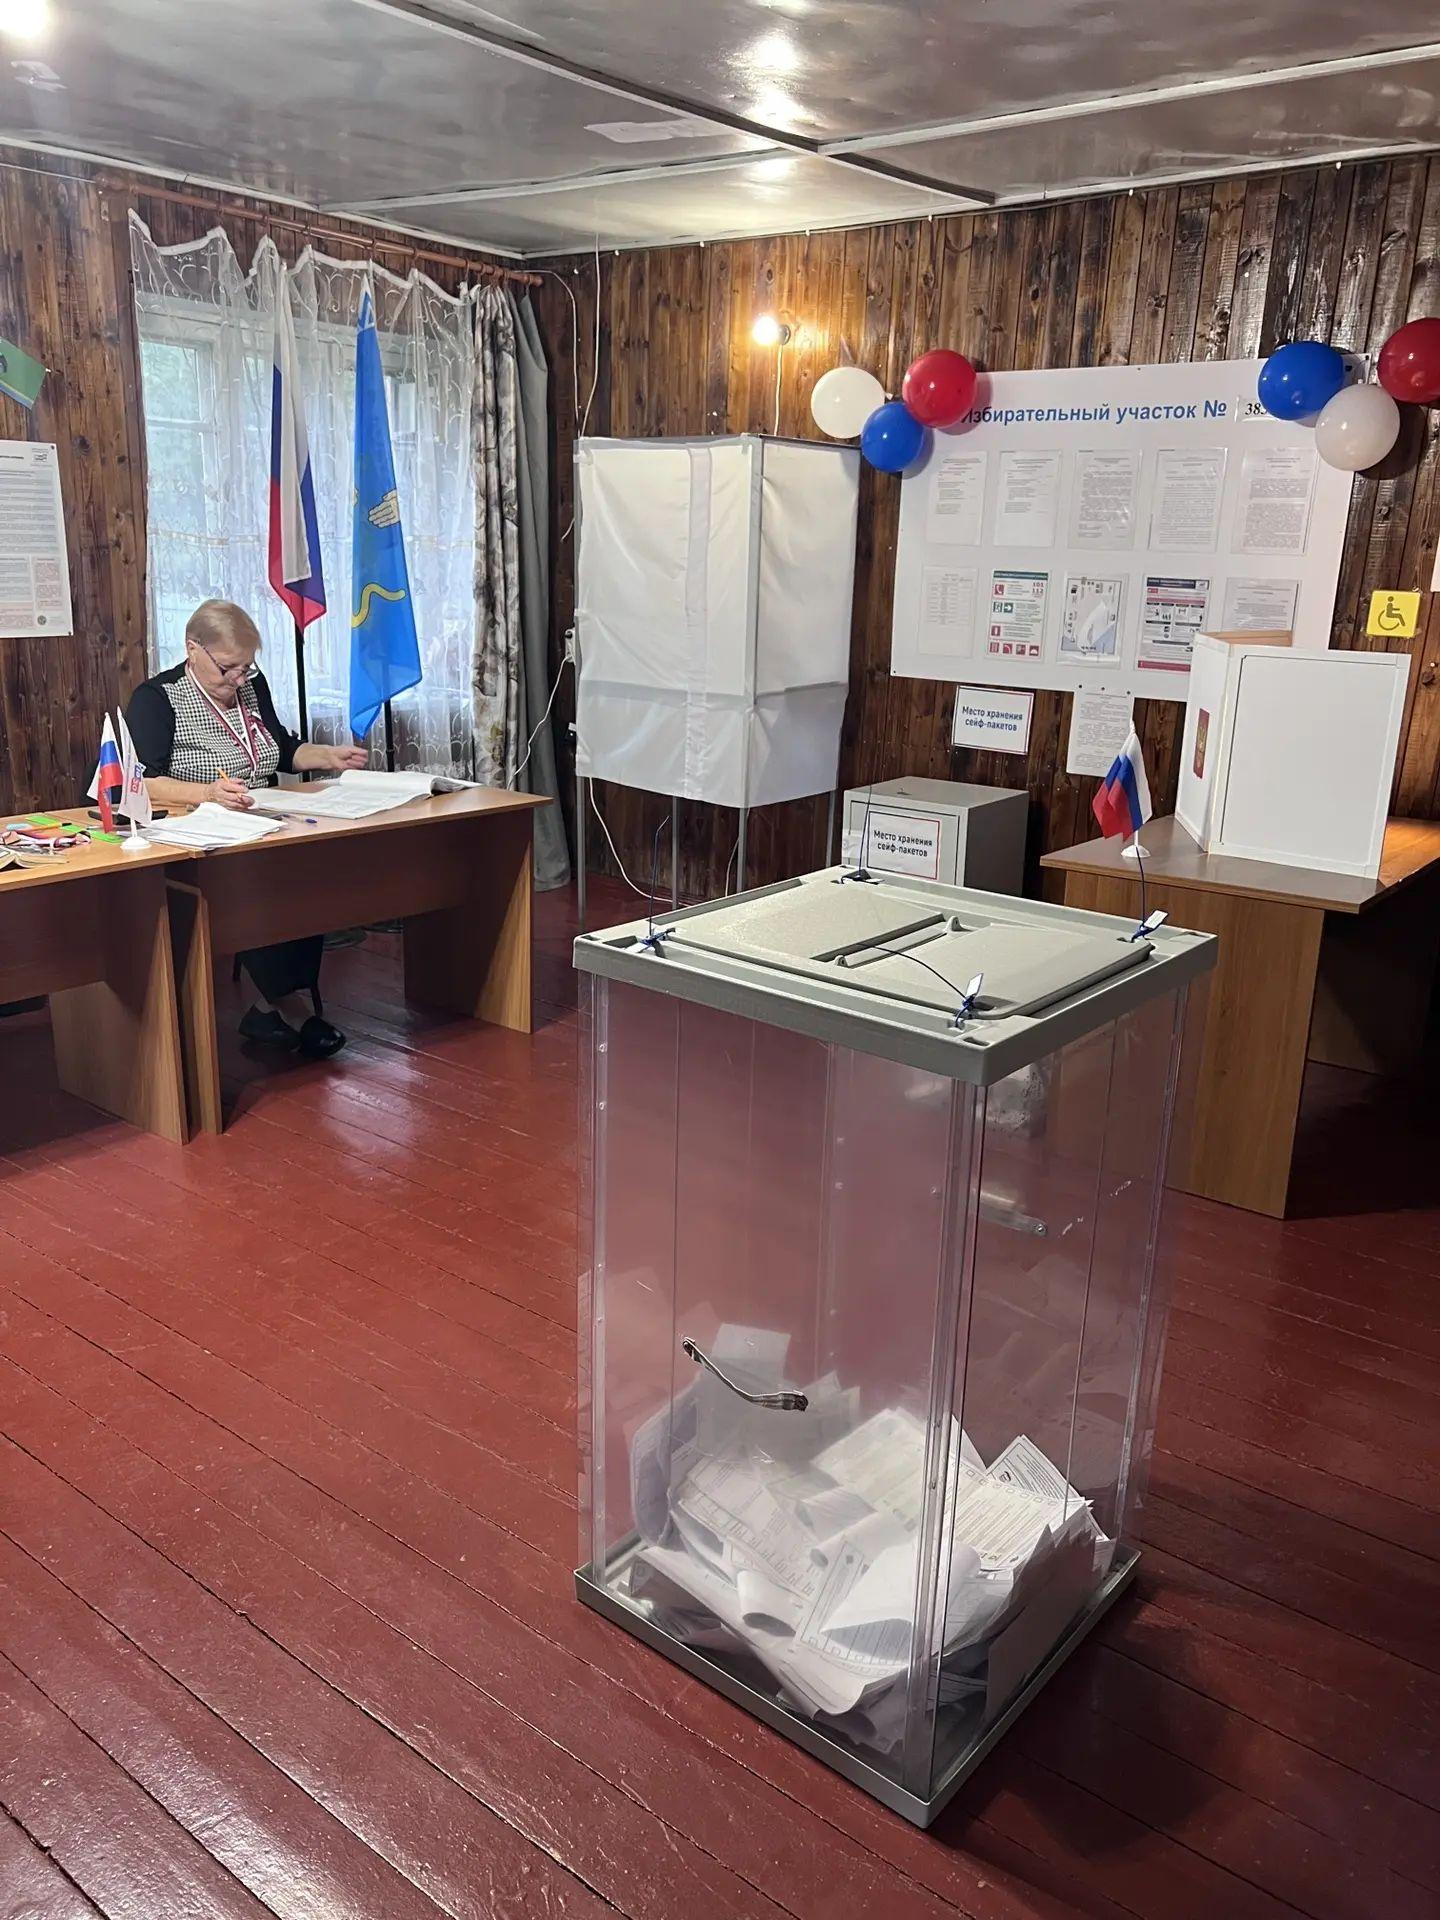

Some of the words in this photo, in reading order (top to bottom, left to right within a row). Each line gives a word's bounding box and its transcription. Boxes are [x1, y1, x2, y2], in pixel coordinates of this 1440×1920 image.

[1115, 404, 1197, 425] участок
[1203, 399, 1227, 418] №
[961, 706, 986, 717] Место
[986, 710, 1023, 721] хранения
[965, 717, 1018, 731] сейф-пакетов
[873, 829, 897, 841] Место
[897, 835, 933, 847] хранения
